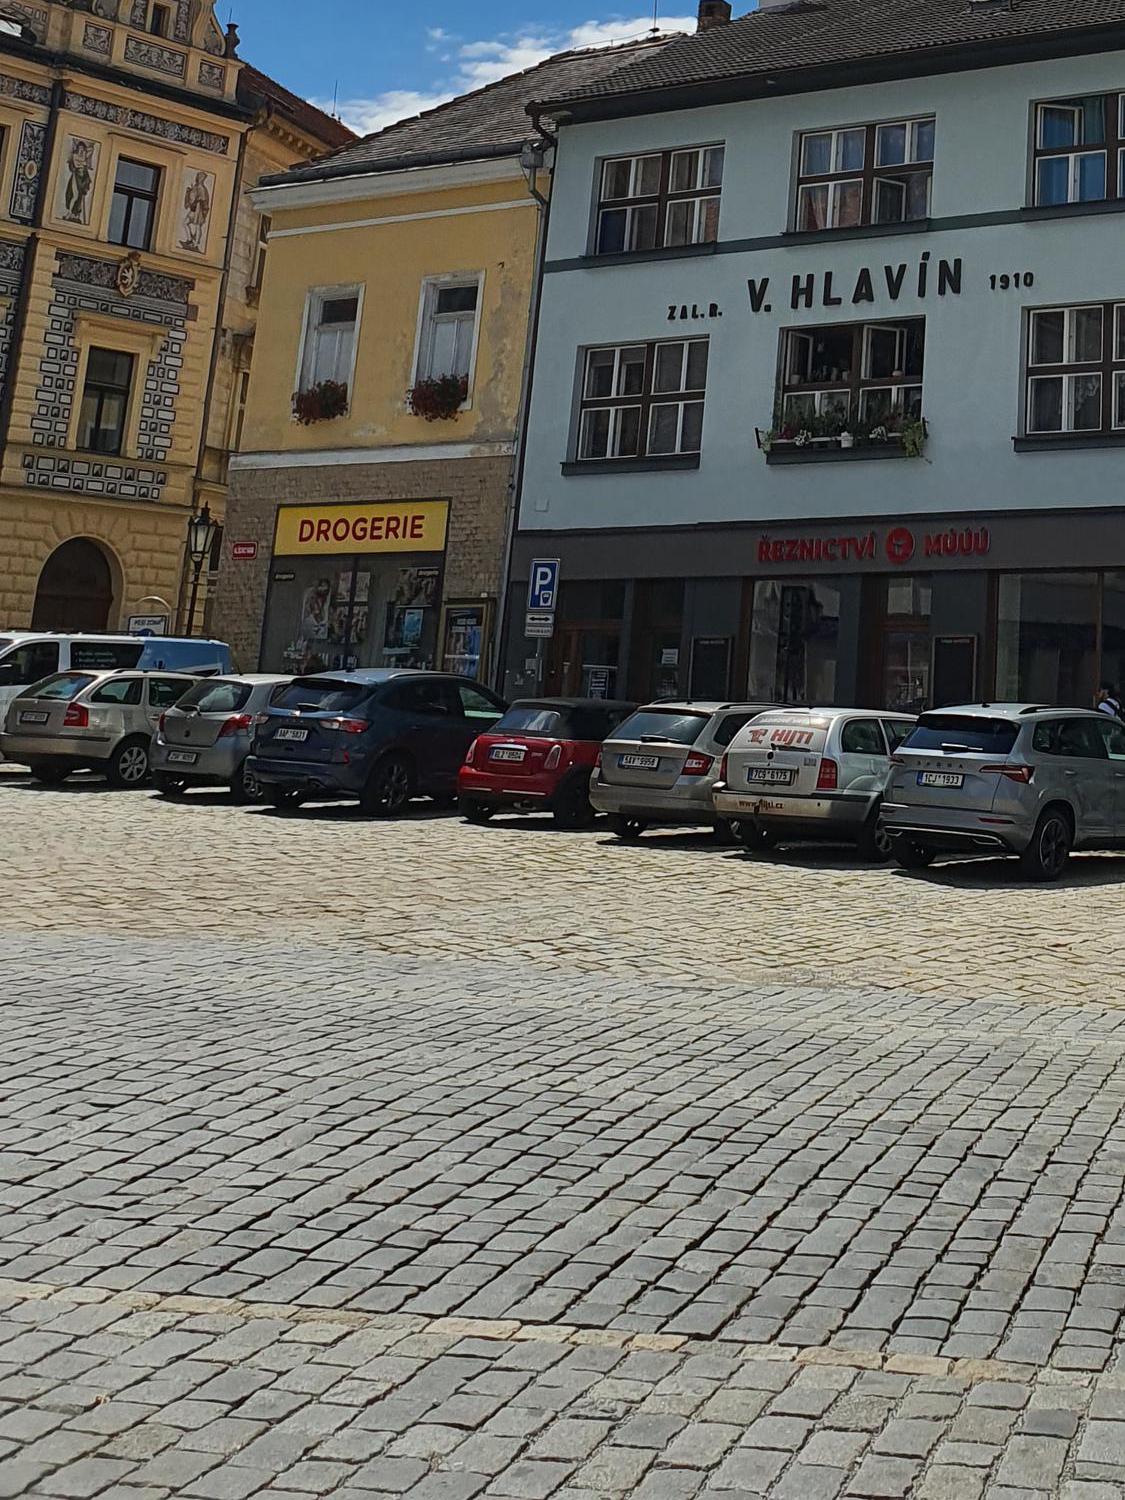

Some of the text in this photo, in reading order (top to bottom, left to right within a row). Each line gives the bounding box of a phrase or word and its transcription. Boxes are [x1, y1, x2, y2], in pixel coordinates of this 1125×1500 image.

[748, 277, 772, 313] V.
[790, 251, 963, 310] HLAVÍN
[989, 271, 1034, 291] 1910
[298, 515, 425, 543] DROGERIE
[756, 531, 876, 563] ŘEZNICTVÍ
[534, 566, 552, 596] P
[770, 729, 814, 747] HIJTI
[770, 770, 787, 780] 6175
[942, 775, 959, 785] 1933
[739, 799, 783, 811] wwwijti.cz
